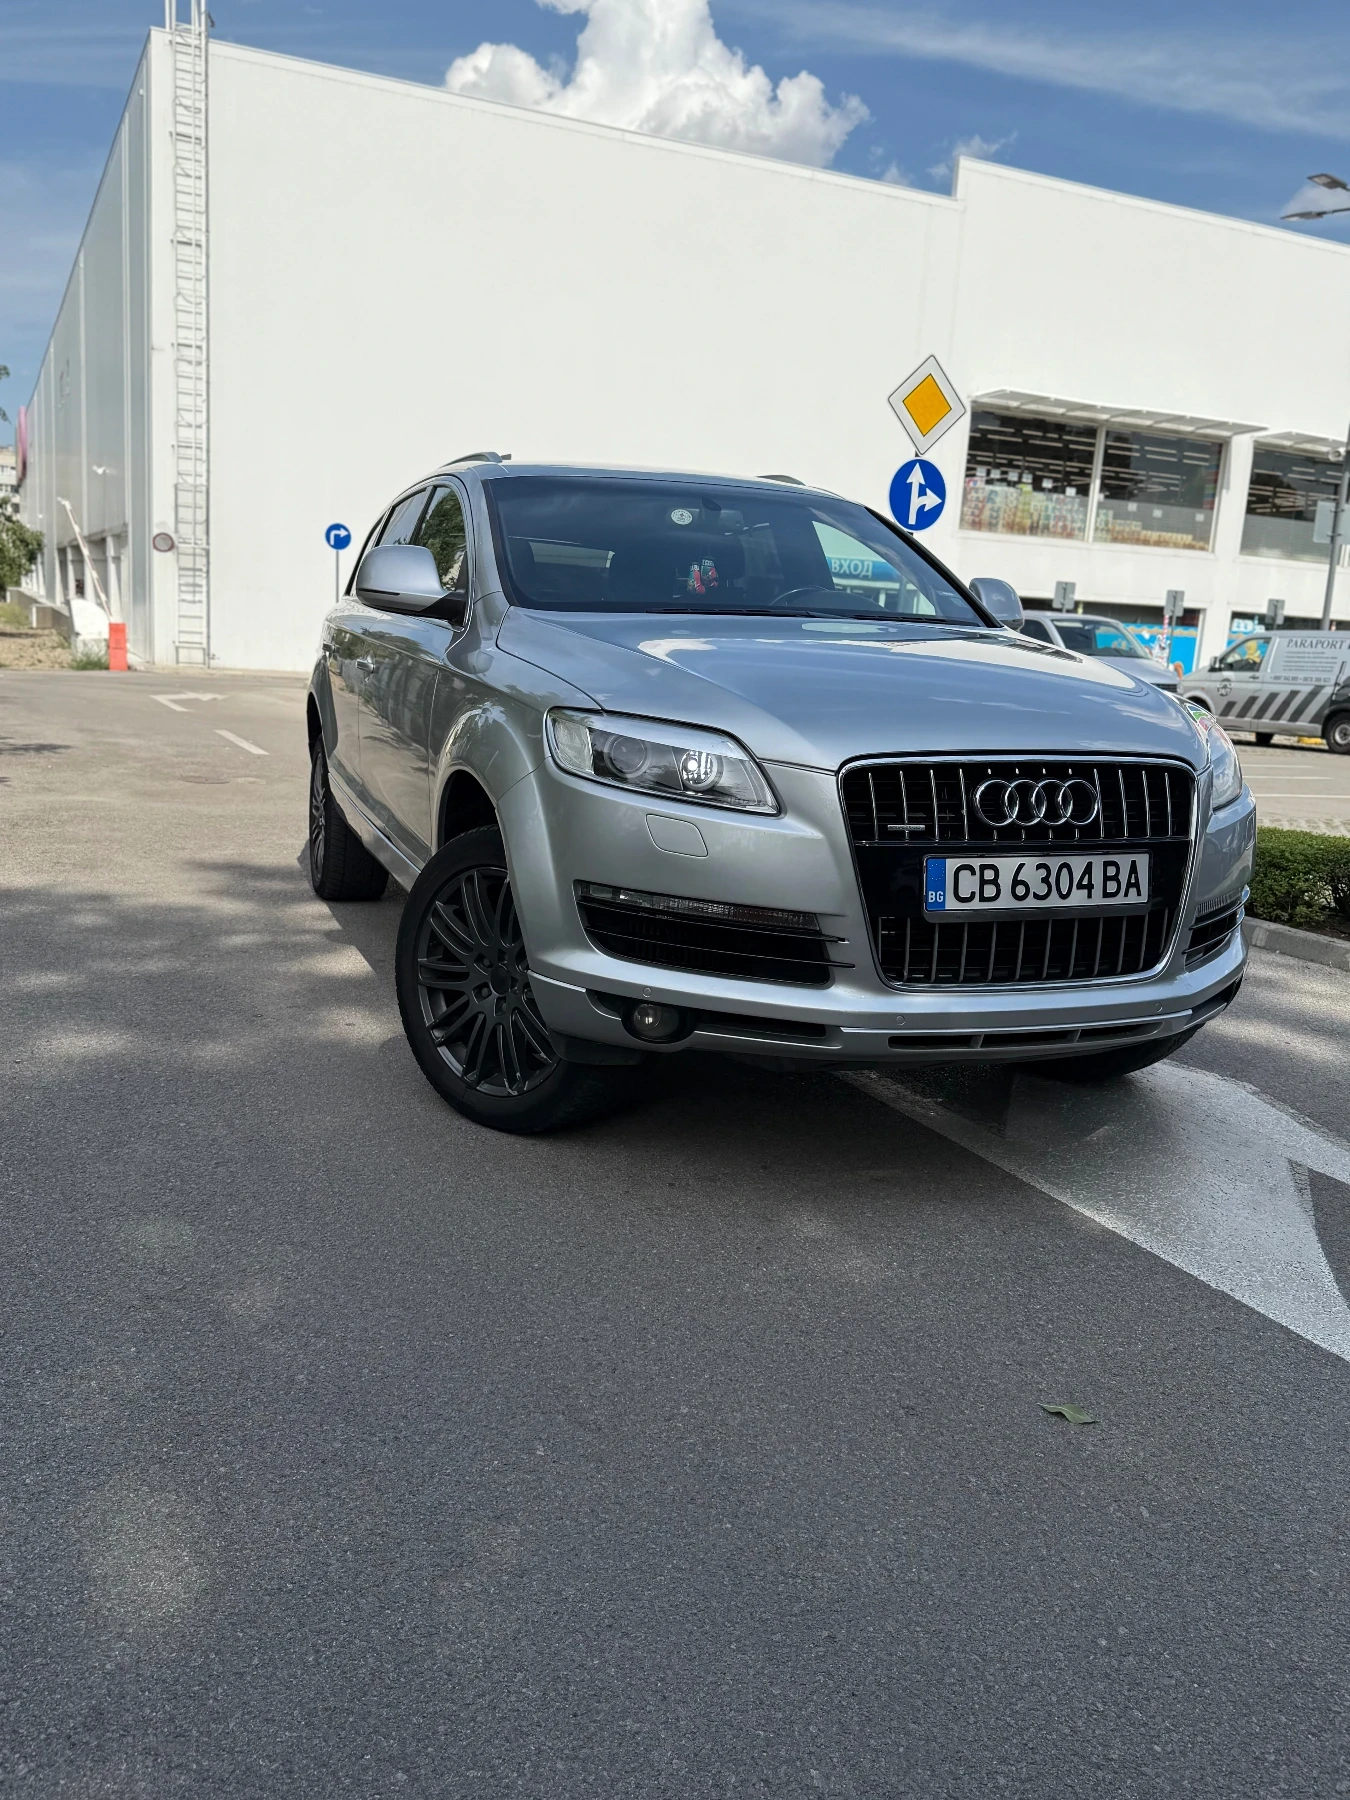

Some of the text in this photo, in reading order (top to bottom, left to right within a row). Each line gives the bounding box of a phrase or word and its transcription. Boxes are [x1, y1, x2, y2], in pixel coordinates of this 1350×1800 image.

[831, 558, 873, 579] ВХОД
[1287, 638, 1346, 650] PARAPORT
[953, 859, 1142, 903] CB 6304 BA
[928, 891, 944, 903] BG
